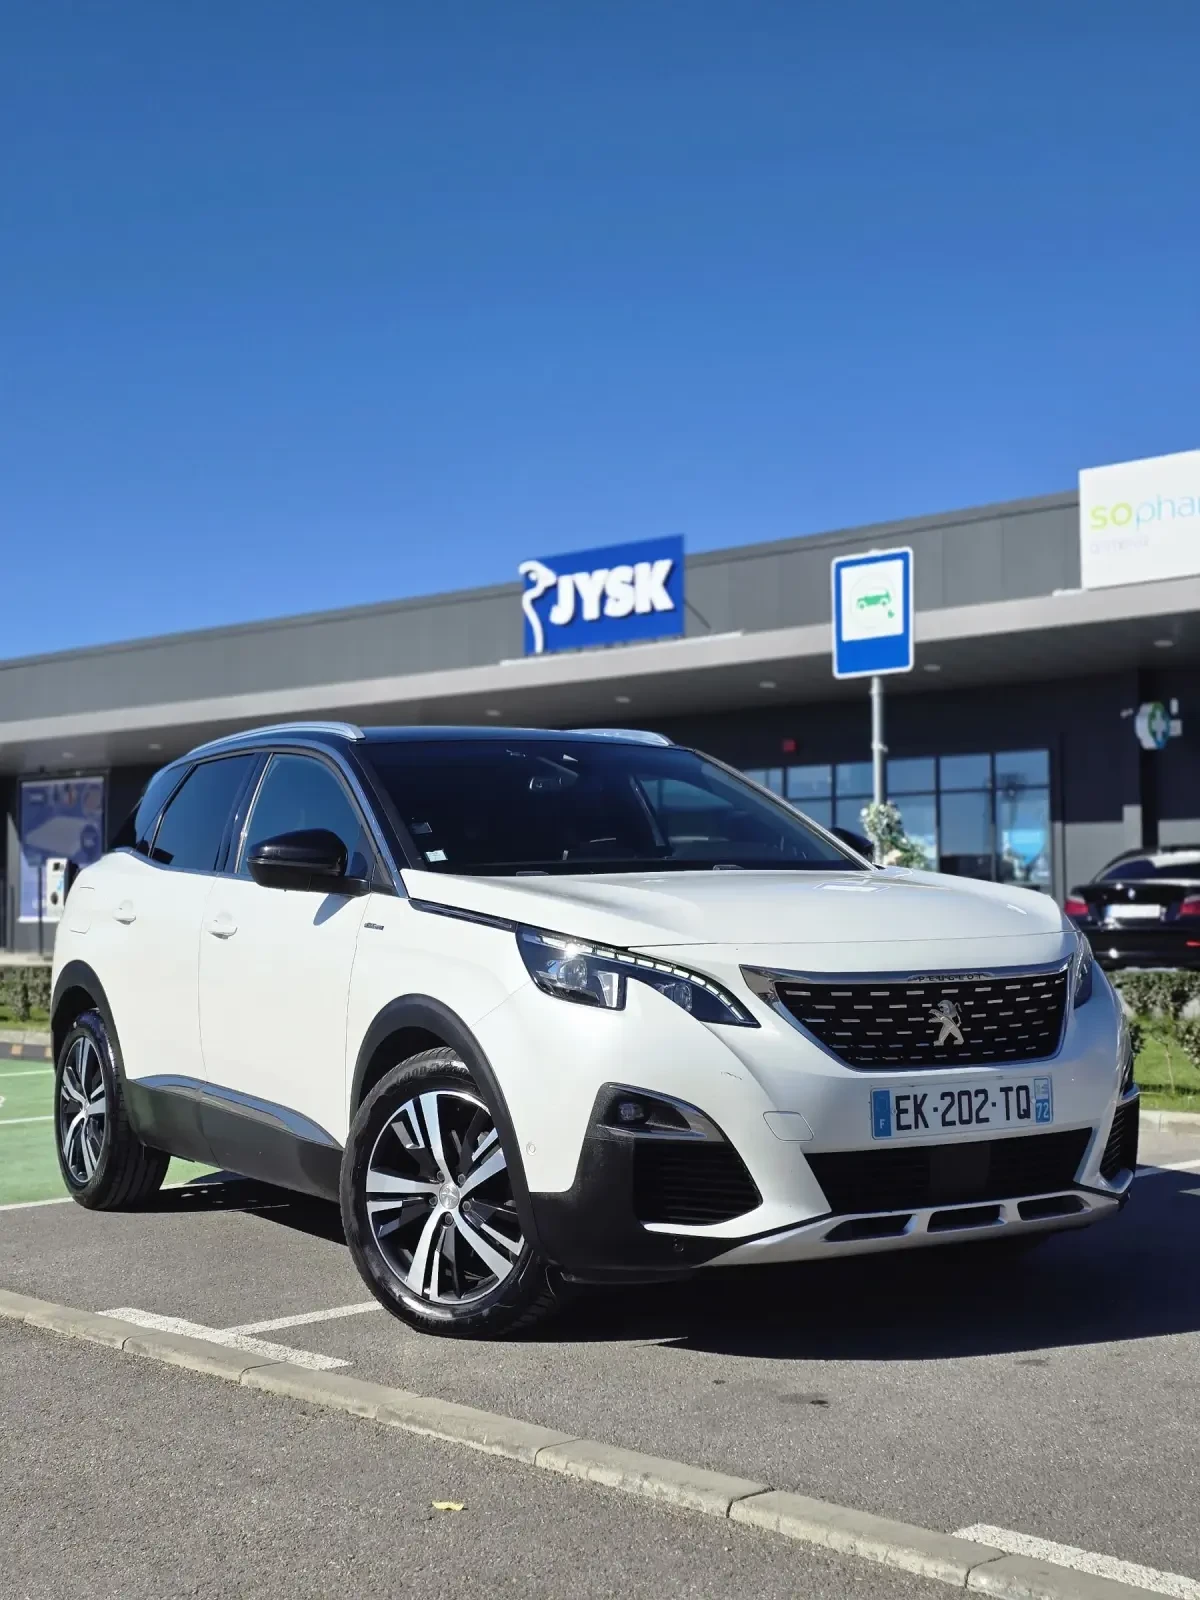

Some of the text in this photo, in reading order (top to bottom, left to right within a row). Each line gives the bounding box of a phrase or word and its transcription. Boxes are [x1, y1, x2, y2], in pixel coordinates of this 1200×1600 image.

[550, 559, 675, 625] JYSK
[918, 974, 983, 983] PEUGEOT
[880, 1119, 886, 1129] F
[1036, 1102, 1049, 1119] 72
